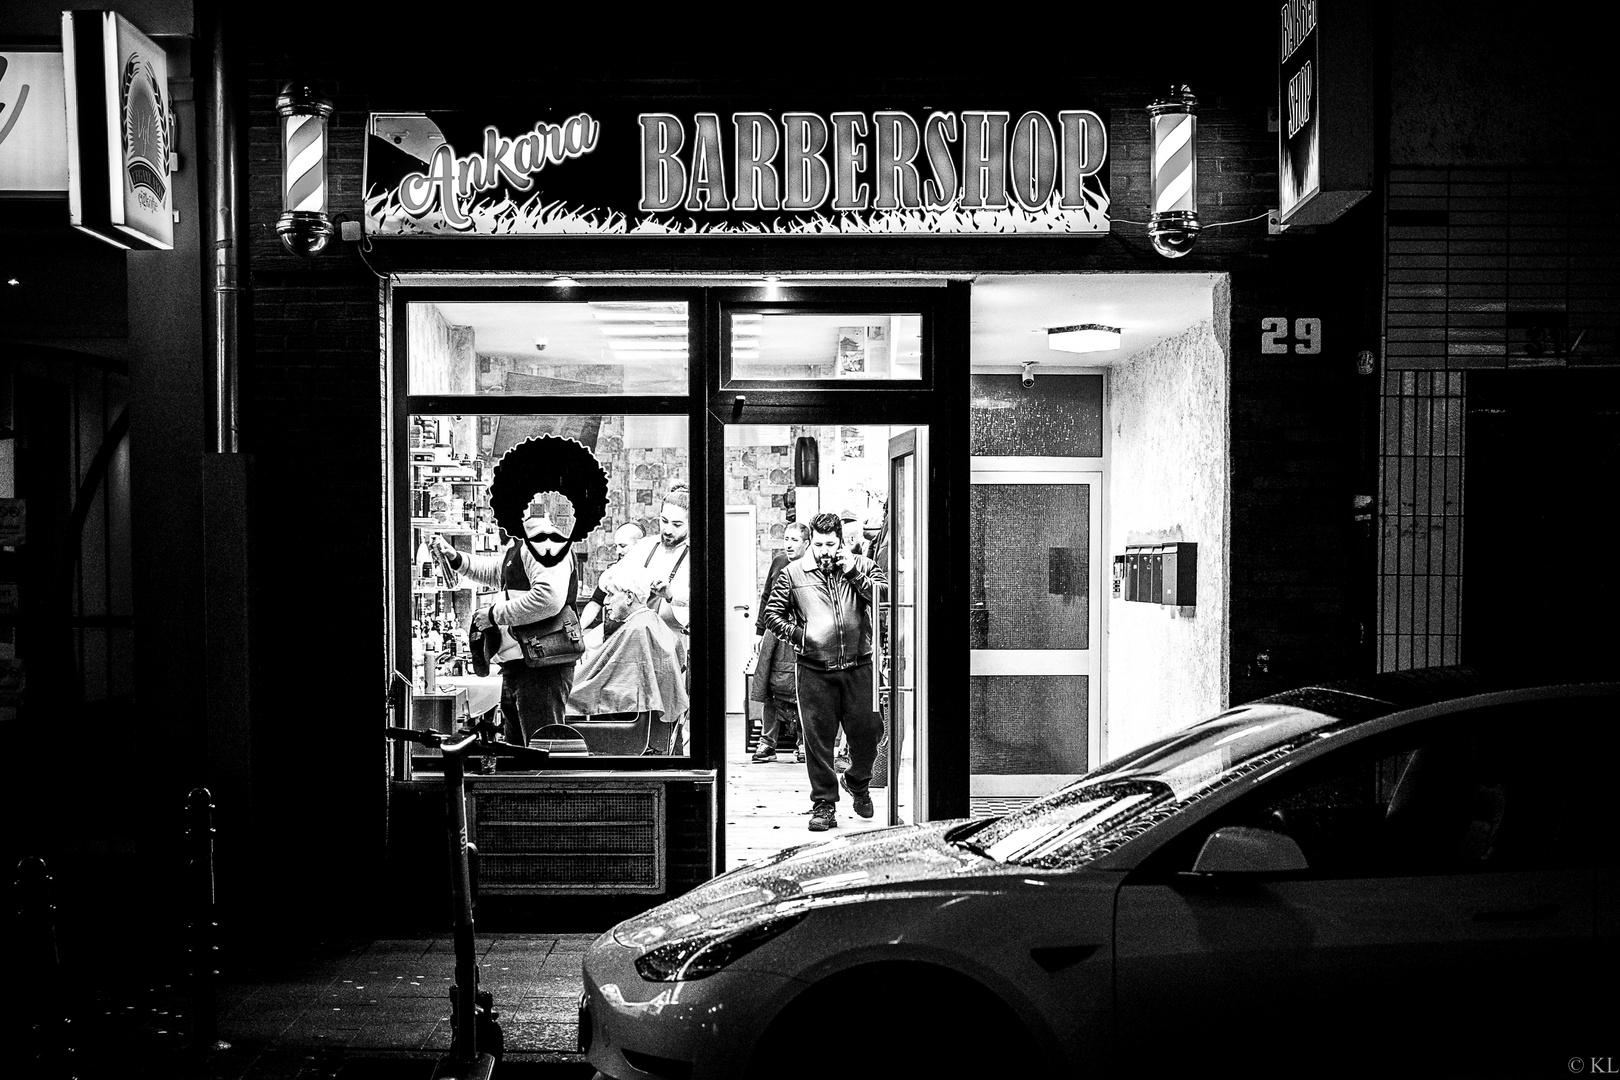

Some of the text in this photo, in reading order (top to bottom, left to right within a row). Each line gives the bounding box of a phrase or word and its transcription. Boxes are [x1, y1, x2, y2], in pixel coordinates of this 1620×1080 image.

[1288, 60, 1312, 139] SHOP
[399, 110, 1108, 231] Ankara BARBERSHOP
[1261, 316, 1322, 355] 29
